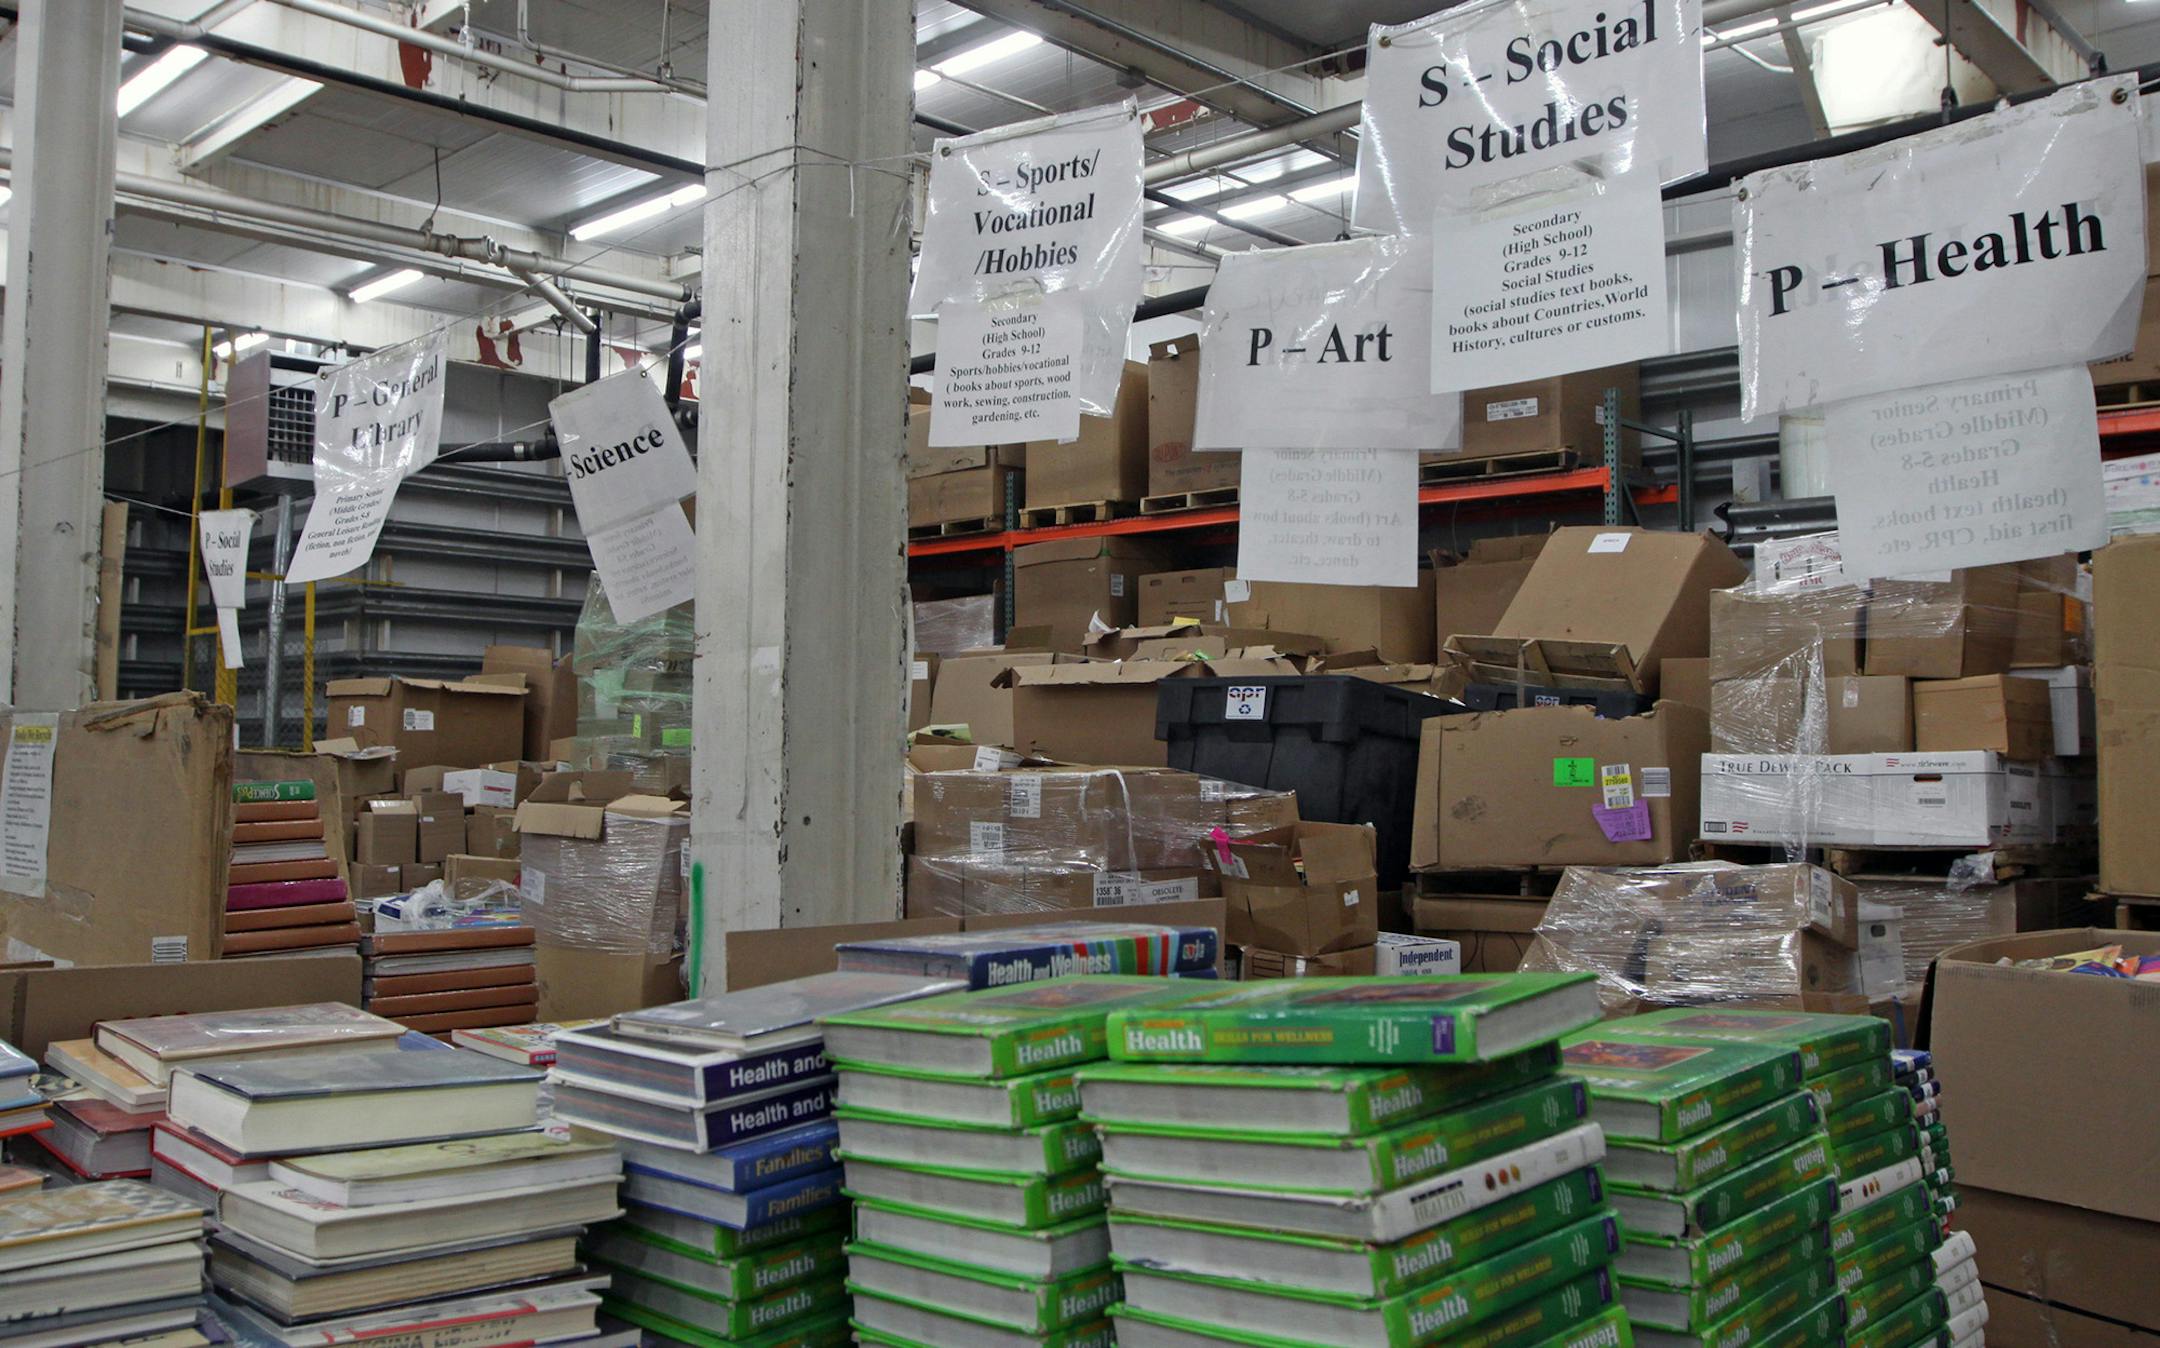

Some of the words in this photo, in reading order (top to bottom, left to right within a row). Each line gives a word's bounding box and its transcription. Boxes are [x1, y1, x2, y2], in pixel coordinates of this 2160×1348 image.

[1419, 64, 1448, 108] S
[1507, 0, 1657, 85] Social
[1445, 94, 1627, 170] Studies
[977, 170, 991, 197] S
[1016, 149, 1101, 195] Sports/
[974, 192, 1095, 236] Vocational
[1513, 210, 1582, 236] Secondary
[1503, 239, 1540, 258] (High
[1544, 225, 1593, 248] School)
[974, 241, 1078, 276] /Hobbies
[1504, 254, 1552, 273] Grades
[1559, 244, 1588, 261] 9-12
[1768, 264, 1803, 317] P
[1876, 202, 2107, 292] Health
[1502, 274, 1542, 292] Social
[1545, 263, 1594, 283] Studies
[1449, 318, 1488, 336] books
[1492, 312, 1530, 330] about
[1605, 285, 1648, 305] World
[1464, 299, 1506, 318] (social
[1510, 290, 1556, 308] studies
[1560, 284, 1585, 297] text
[1589, 271, 1633, 291] books,
[982, 331, 1008, 346] (High
[1010, 327, 1046, 342] School)
[991, 313, 1038, 328] Secondary
[1452, 335, 1506, 353] History,
[1509, 326, 1563, 345] cultures
[1567, 322, 1582, 333] or
[1586, 308, 1645, 329] customs.
[982, 346, 1016, 360] Grades
[1021, 343, 1041, 356] 9-12
[1246, 327, 1273, 366] P
[1317, 323, 1393, 363] Art
[950, 355, 1070, 379] Sports/hobbies/vocational
[953, 380, 982, 393] books
[985, 377, 1012, 391] about
[1014, 376, 1044, 391] sports,
[1047, 371, 1072, 385] wood
[332, 393, 350, 418] P
[373, 354, 438, 407] General
[944, 397, 973, 409] work,
[975, 395, 1010, 410] sewing,
[1012, 390, 1071, 405] construction,
[352, 410, 424, 450] Library
[971, 409, 1022, 425] gardening,
[1024, 408, 1040, 419] etc.
[571, 427, 665, 479] Science
[205, 531, 211, 549] P
[217, 531, 241, 549] Social
[1229, 687, 1265, 702] apr
[1719, 760, 1753, 774] TRUE
[988, 955, 1032, 985] Health
[1032, 966, 1050, 979] and
[1050, 952, 1111, 978] Wellness
[1399, 947, 1454, 968] Independent
[1018, 1036, 1082, 1066] Health
[1126, 1025, 1205, 1053] Health
[729, 1060, 788, 1089] Health
[793, 1054, 826, 1077] and
[730, 1105, 789, 1133] Health
[793, 1098, 824, 1121] and
[1036, 1088, 1081, 1113] Heal
[1369, 1085, 1423, 1121] Health
[1677, 1100, 1712, 1129] Health
[756, 1147, 823, 1177] Families
[1395, 1143, 1447, 1179] Health
[1693, 1146, 1727, 1176] Health
[768, 1185, 832, 1217] Families
[755, 1256, 816, 1288] Health
[1394, 1238, 1453, 1279] Health
[1708, 1239, 1743, 1273] Health
[752, 1293, 812, 1326] Health
[1410, 1293, 1469, 1338] Health
[1706, 1283, 1739, 1317] Health
